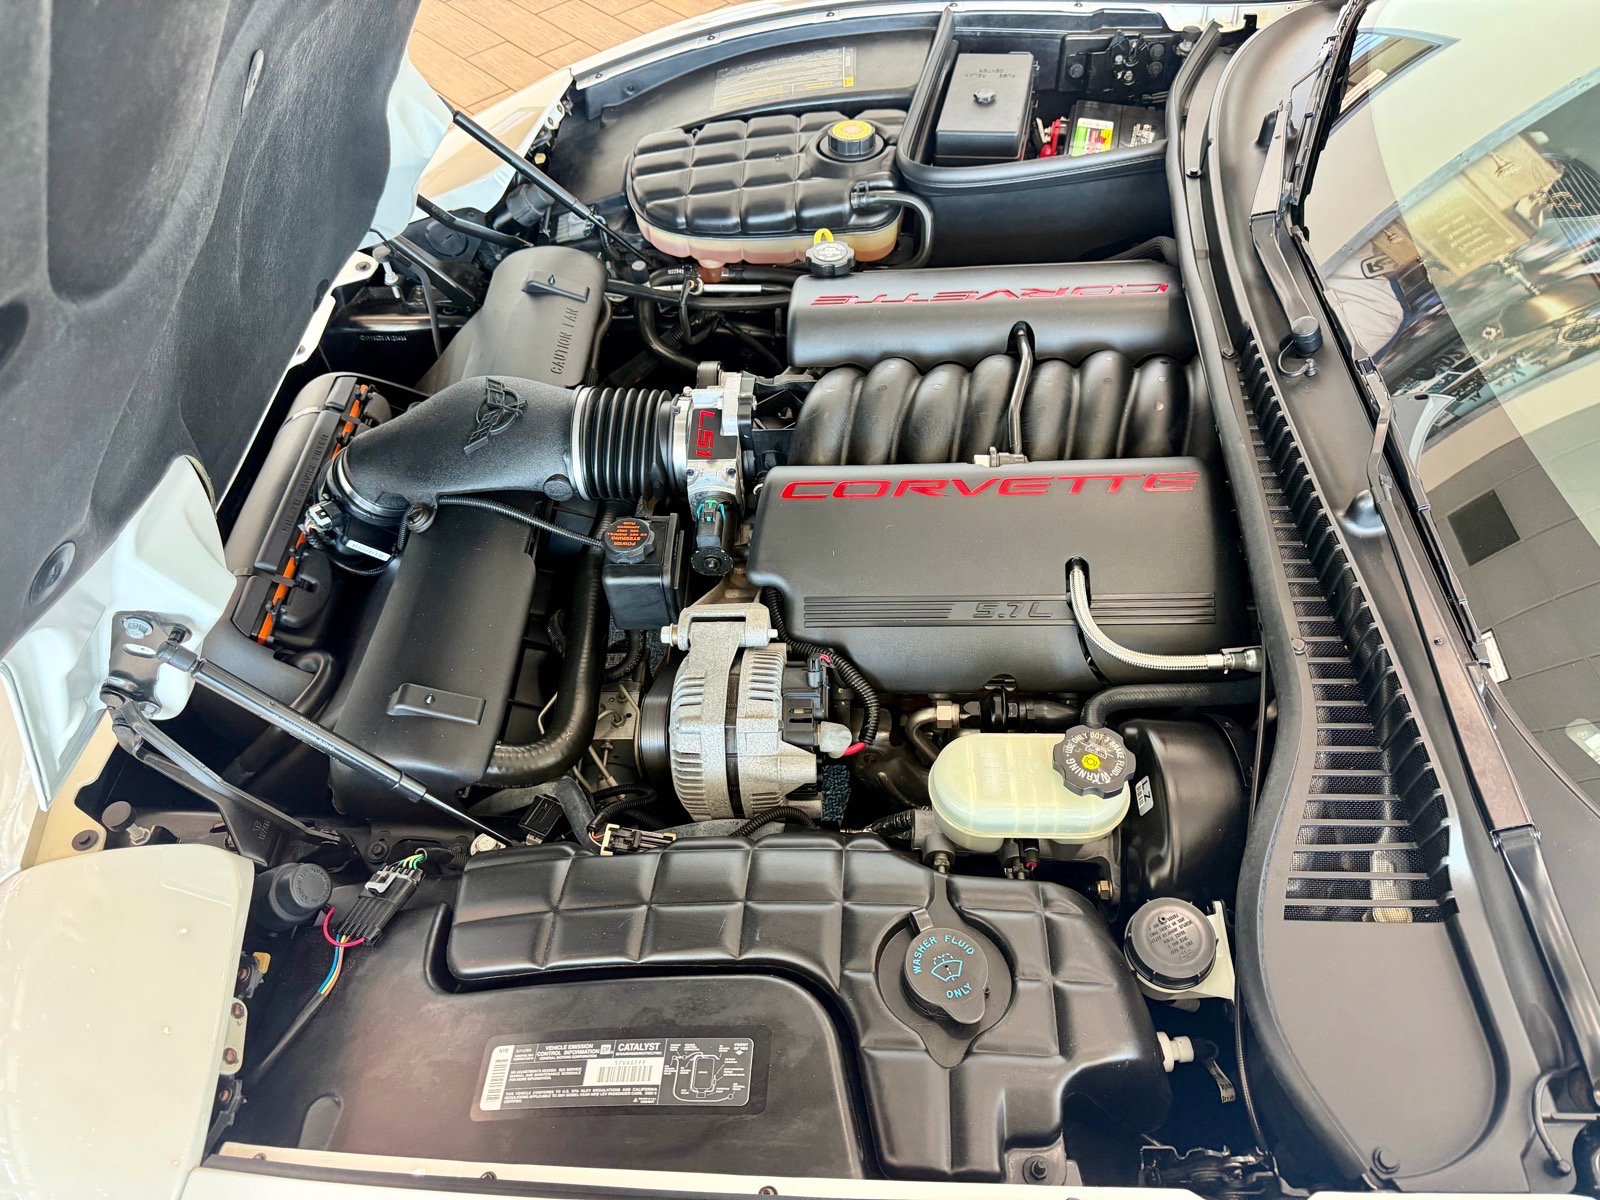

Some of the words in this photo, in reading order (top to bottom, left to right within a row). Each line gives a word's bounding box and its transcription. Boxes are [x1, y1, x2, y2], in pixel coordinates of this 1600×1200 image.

[810, 283, 1169, 306] CORVETTE
[550, 332, 572, 374] CAUTION
[696, 410, 716, 458] LS1
[780, 472, 1200, 500] CORVETTE
[972, 602, 1052, 618] 5.7L
[1071, 732, 1088, 743] ONLY
[1090, 731, 1104, 739] DOT
[1109, 740, 1124, 759] BRAKE
[1065, 758, 1111, 784] WARNING
[1111, 759, 1124, 776] FLUID
[913, 936, 937, 974] WASHER
[945, 934, 974, 955] FLUID
[946, 983, 972, 999] ONLY
[618, 1043, 661, 1051] CATALYST
